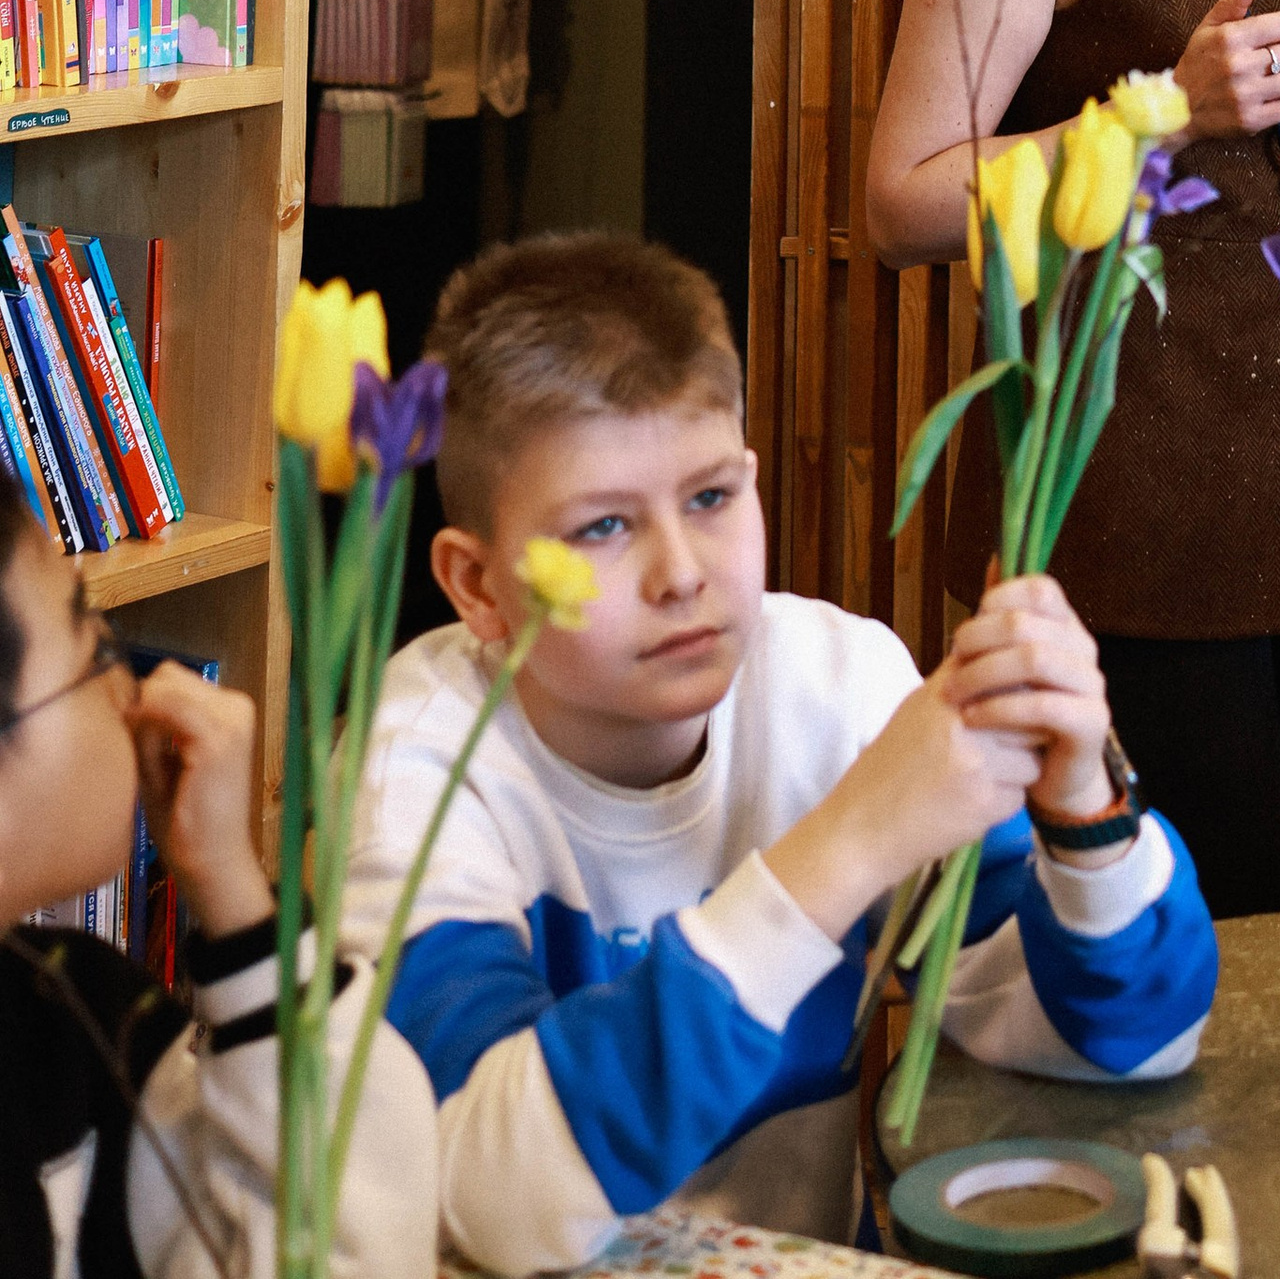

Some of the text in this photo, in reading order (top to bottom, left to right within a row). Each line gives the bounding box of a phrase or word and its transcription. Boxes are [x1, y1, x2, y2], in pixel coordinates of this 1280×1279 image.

[41, 113, 69, 125] ЧТЕНИЕ
[70, 280, 86, 314] АНДРЕЙ
[34, 285, 50, 315] Марина
[59, 359, 77, 389] Рецепт
[71, 390, 94, 437] Единорога
[112, 365, 130, 400] ЧИТАЮ
[2, 373, 22, 416] СЪЕДОБНЫЕ
[16, 416, 32, 448] СЕКРЕТЫ
[21, 369, 35, 398] Крошка
[31, 400, 50, 443] привидение
[4, 412, 24, 459] ХВОСТИКАМИ
[31, 433, 48, 468] ЭРИКСОН
[42, 468, 53, 485] ЭВА
[140, 443, 164, 497] РАННЕЕ ЧТЕНИЕ
